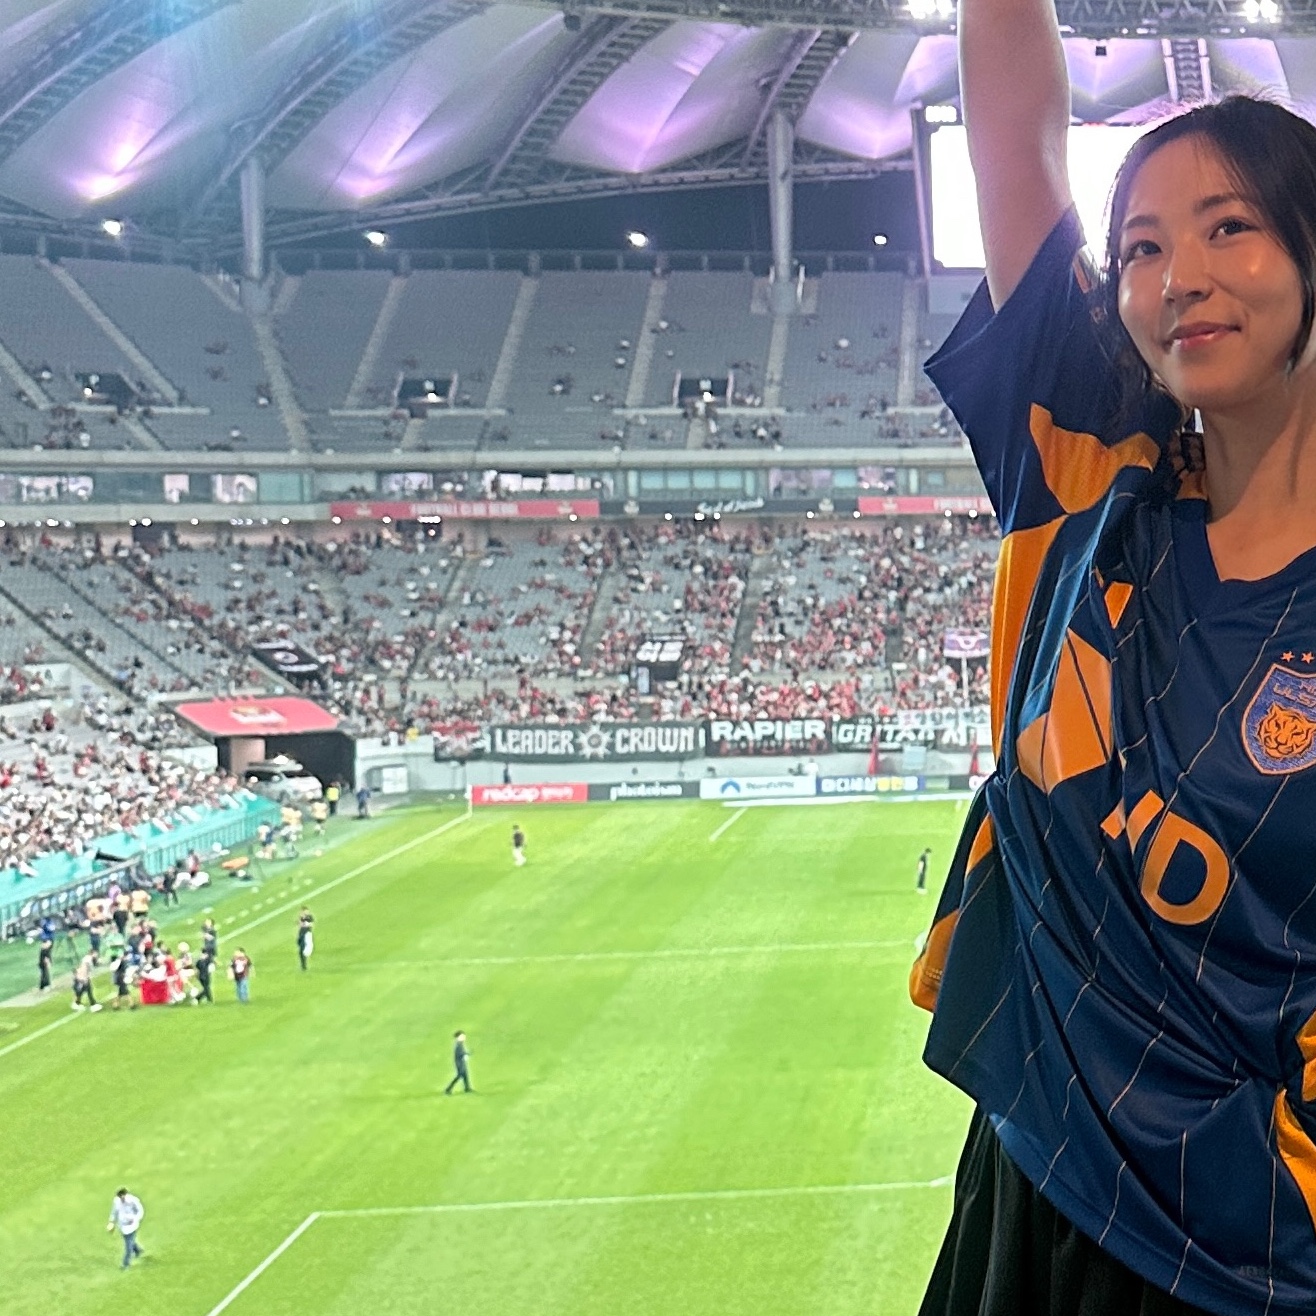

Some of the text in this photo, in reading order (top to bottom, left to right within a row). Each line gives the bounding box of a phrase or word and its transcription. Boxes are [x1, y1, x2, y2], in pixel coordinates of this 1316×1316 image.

[495, 728, 575, 755] LEADER
[615, 727, 695, 752] CROWN
[711, 720, 825, 742] RAPIER
